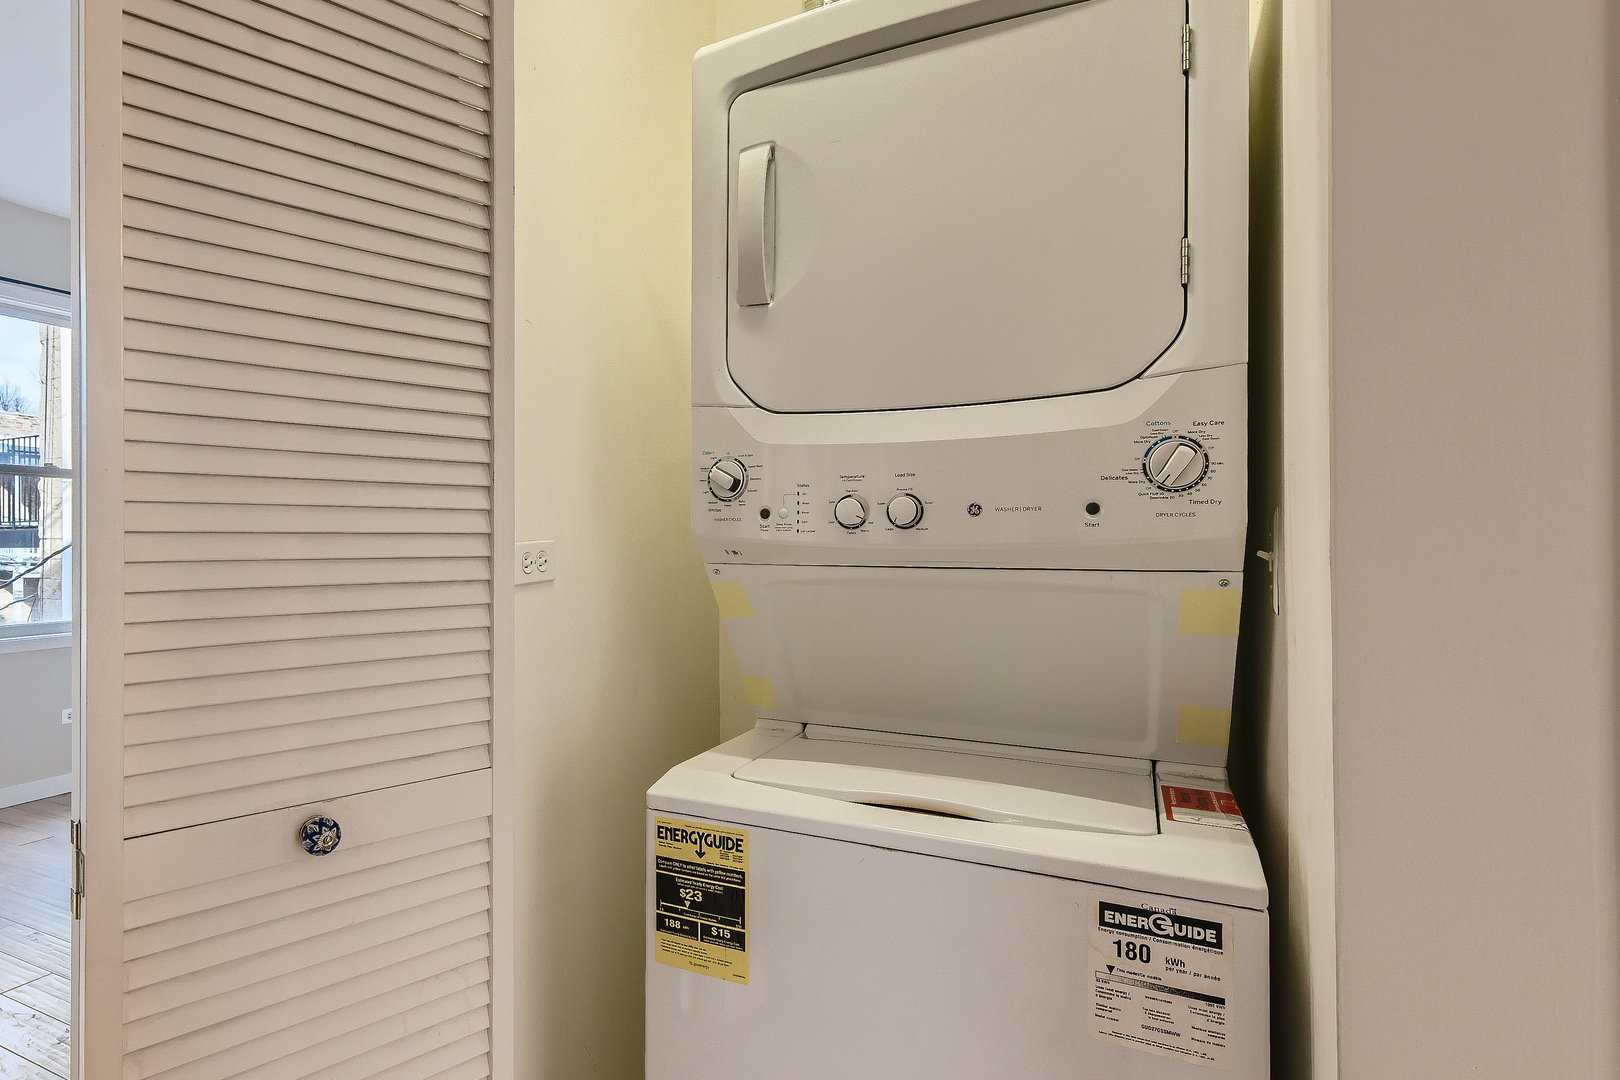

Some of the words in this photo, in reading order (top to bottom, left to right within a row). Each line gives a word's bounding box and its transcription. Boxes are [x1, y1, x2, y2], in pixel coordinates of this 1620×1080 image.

[657, 825, 743, 853] ENERGYGUIDE
[679, 888, 703, 902] $23
[664, 918, 681, 929] 188
[1104, 910, 1216, 943] ENERGUIDE
[711, 927, 730, 938] $15
[1116, 930, 1148, 940] consumption
[1153, 937, 1190, 949] Consommation
[1112, 939, 1151, 964] 180
[1165, 957, 1185, 968] kWh
[1204, 973, 1221, 981] année
